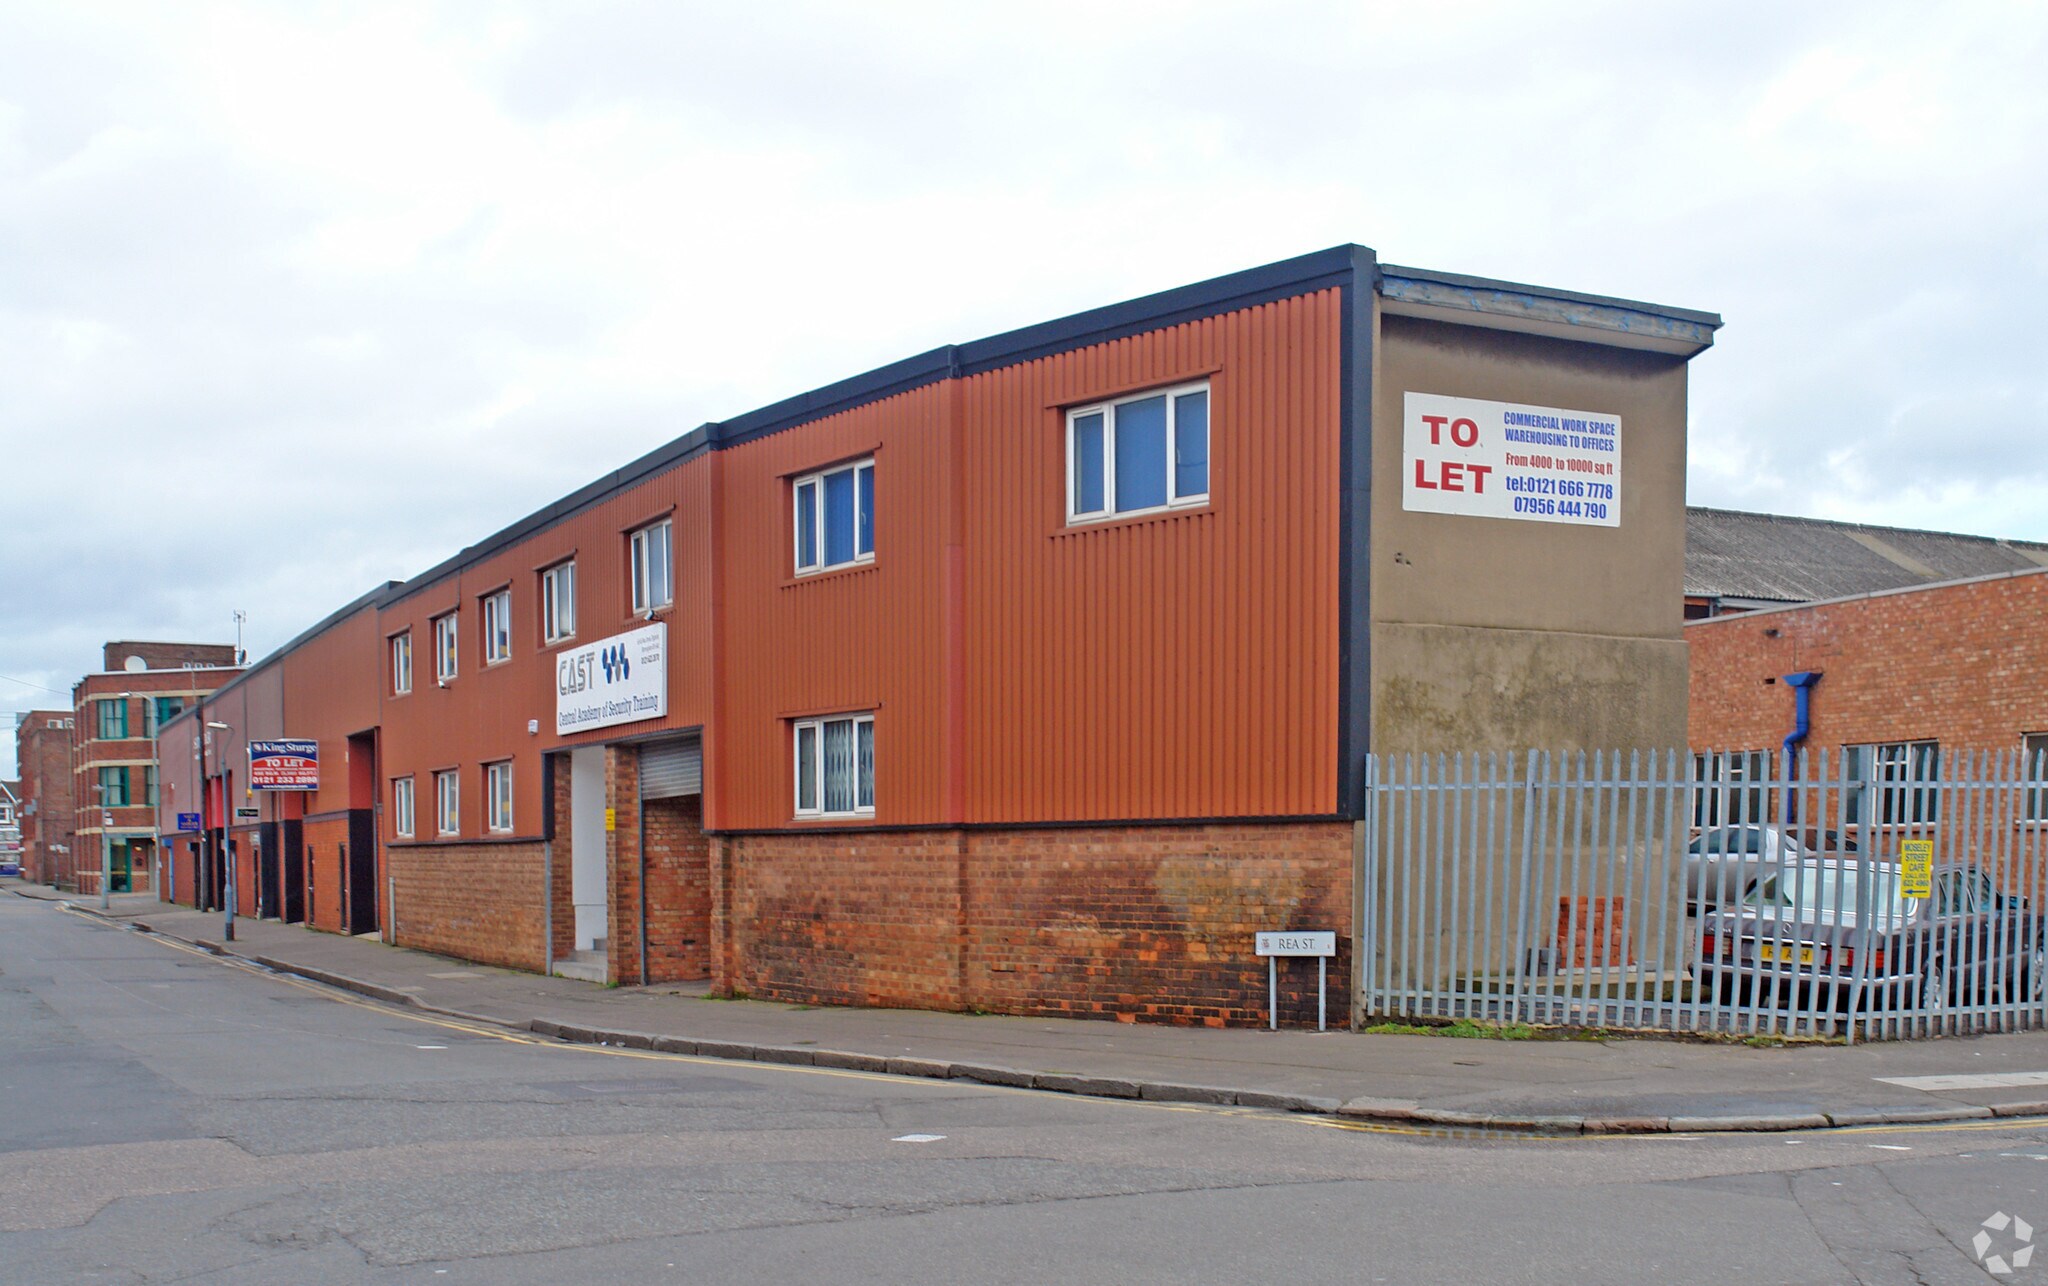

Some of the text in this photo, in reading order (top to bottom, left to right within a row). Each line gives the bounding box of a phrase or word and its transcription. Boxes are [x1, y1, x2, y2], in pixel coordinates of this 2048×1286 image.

[1422, 415, 1479, 448] TO
[1504, 411, 1615, 436] COMMERCIAL WORK SPACE
[1505, 428, 1614, 452] WAREHOUSING TO OFFICES
[1506, 452, 1613, 475] From 4000 to 10000 sq ft
[1415, 459, 1492, 494] LET
[1506, 476, 1613, 500] tel:0121 666 7778
[1514, 496, 1607, 519] 07956 444 790
[559, 651, 595, 696] CAST
[559, 707, 577, 727] Central
[577, 705, 601, 722] Academy
[608, 697, 632, 717] Security
[633, 692, 658, 711] Training
[262, 743, 286, 754] King
[265, 758, 304, 767] TO LET
[1278, 938, 1300, 949] REA
